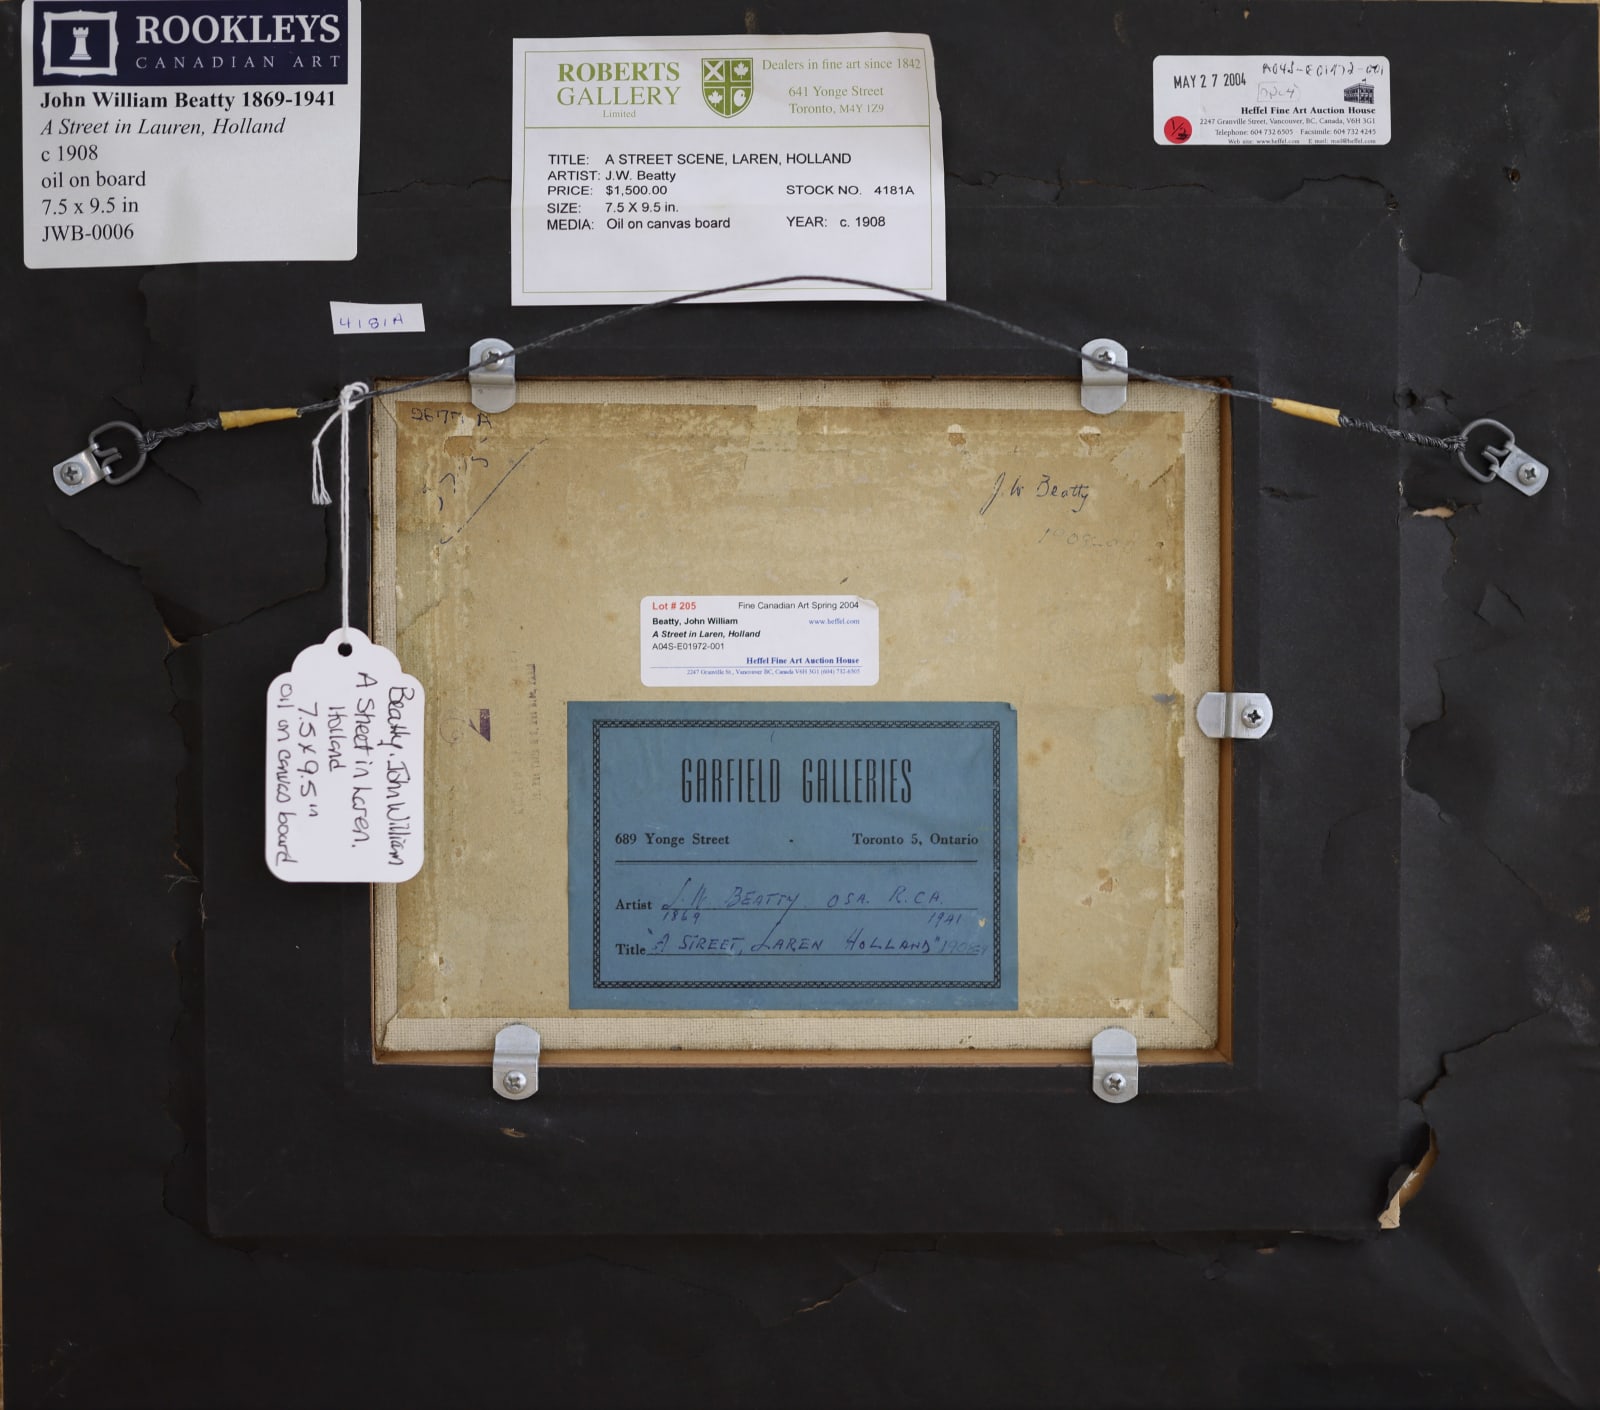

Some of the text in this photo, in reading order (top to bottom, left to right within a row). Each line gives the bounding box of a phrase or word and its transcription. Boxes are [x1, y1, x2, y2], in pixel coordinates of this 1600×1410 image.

[136, 14, 340, 44] ROOKLEYS
[136, 56, 340, 68] CANADIAN ART
[763, 56, 921, 70] Dealers in fine art since 1842
[558, 62, 679, 82] ROBERTS
[1174, 73, 1246, 88] MAY 2 7 2004
[557, 87, 680, 105] GALLERY
[789, 86, 883, 99] 641 Yonge Street
[40, 90, 336, 111] John William Beatty 1869-1941
[789, 103, 884, 114] Toronto, M4Y 1Z9
[40, 117, 285, 136] A Street in Lauren, Holland
[1216, 128, 1248, 137] Telephone:
[41, 145, 97, 162] c 1908
[548, 153, 851, 165] TITLE: A STREET SCENE, LAREN, HOLLAND
[42, 171, 145, 188] oil on board
[548, 170, 676, 182] ARTIST: J.W. Beatty
[548, 185, 667, 196] PRICE: $1,500.00
[787, 185, 914, 195] STOCK NO. 4181A
[42, 197, 138, 215] 7.5 x 9.5 in
[547, 202, 678, 213] SIZE: 7.5 X 9.5 in.
[547, 217, 730, 230] MEDIA: Oil on canvas board
[787, 216, 885, 227] YEAR: c. 1908
[42, 224, 133, 242] JWB-0006
[653, 602, 668, 610] Lot
[680, 602, 696, 610] 205
[812, 602, 837, 610] Spring
[653, 618, 681, 626] Beatty,
[764, 668, 774, 676] BC,
[682, 758, 911, 803] GARFIELD GALLERIES
[615, 833, 729, 848] 689 Yonge Street
[852, 833, 979, 845] Toronto 5, Ontario
[616, 899, 652, 910] Artist
[616, 944, 645, 955] Title
